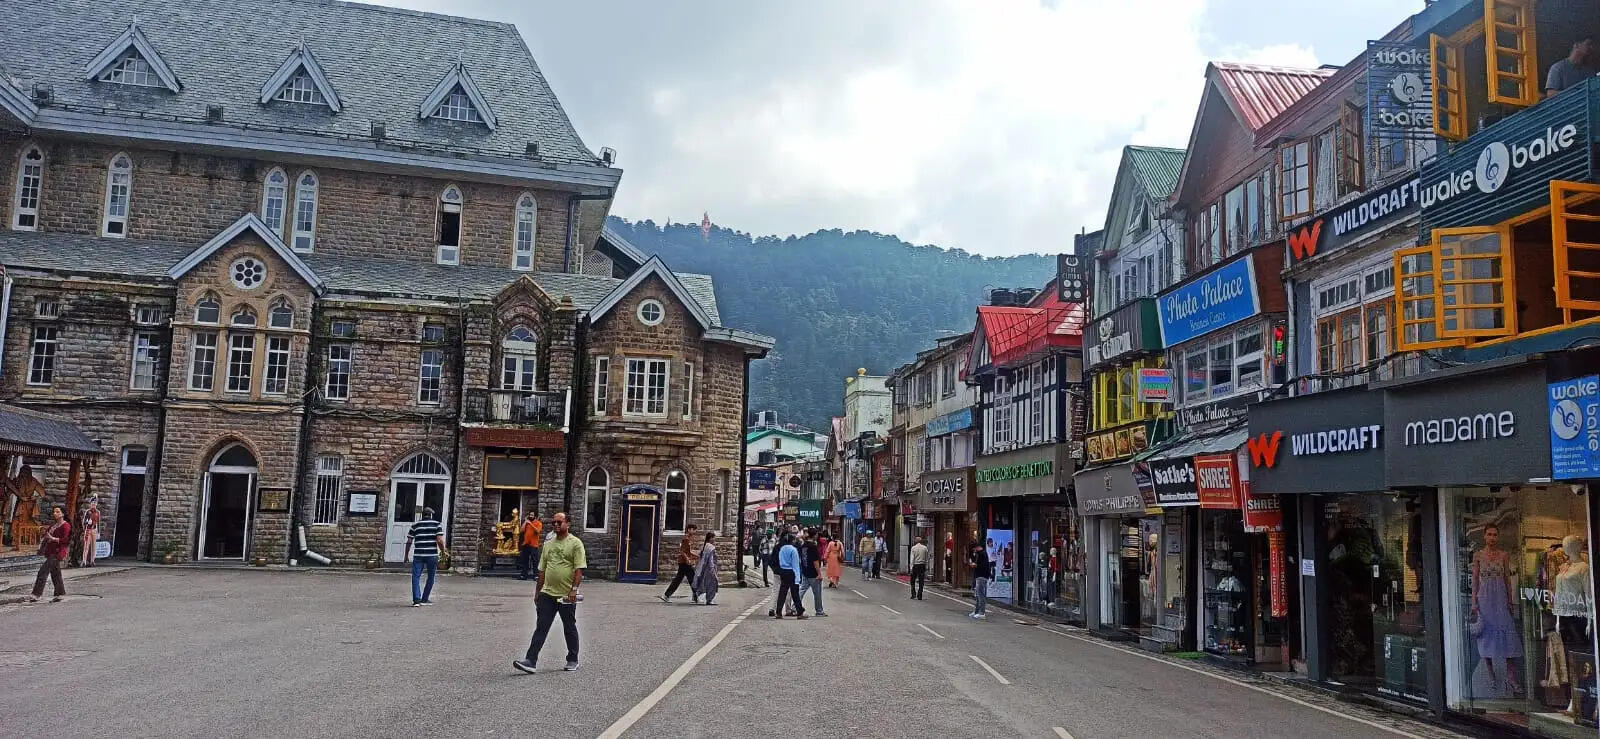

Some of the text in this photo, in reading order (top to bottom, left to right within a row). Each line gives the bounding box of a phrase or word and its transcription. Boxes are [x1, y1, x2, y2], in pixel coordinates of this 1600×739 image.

[1374, 48, 1431, 66] wake
[1381, 108, 1433, 126] bake
[1421, 124, 1577, 209] wake bake
[1334, 178, 1421, 236] WILDCRAFT
[1168, 273, 1244, 324] Photo Palace
[1552, 380, 1598, 400] wake
[1184, 410, 1204, 427] Photo
[1204, 402, 1230, 422] Palace
[1586, 404, 1599, 451] bake
[1292, 425, 1380, 456] WILDCRAFT
[925, 477, 962, 494] OCTAVE
[1154, 463, 1195, 485] Sathe's
[1200, 466, 1231, 489] SHREE
[1247, 499, 1280, 510] SHREE
